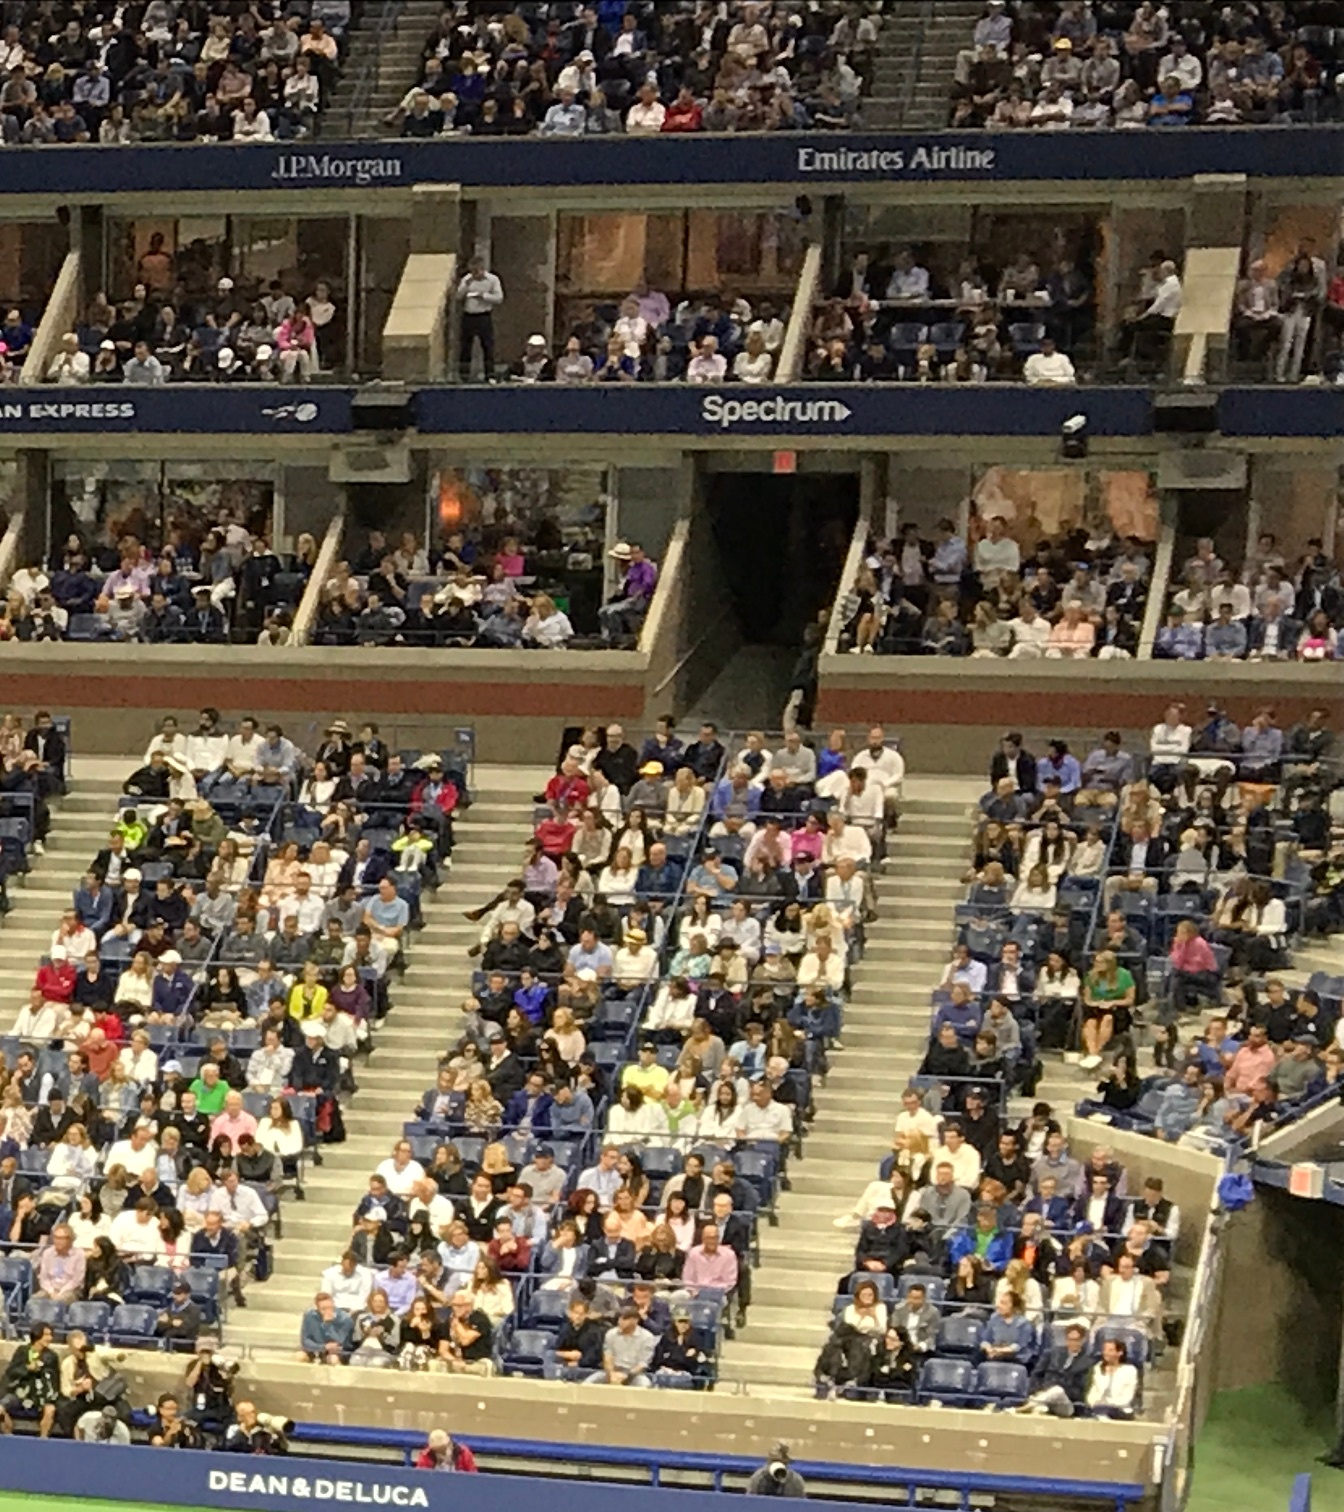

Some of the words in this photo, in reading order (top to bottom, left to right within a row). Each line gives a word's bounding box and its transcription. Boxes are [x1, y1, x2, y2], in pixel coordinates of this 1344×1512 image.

[271, 154, 402, 182] J.P.Morgan
[797, 147, 903, 172] Emirates
[911, 145, 995, 169] Airline
[30, 402, 135, 419] EXPRESS
[702, 393, 843, 427] Spectrum
